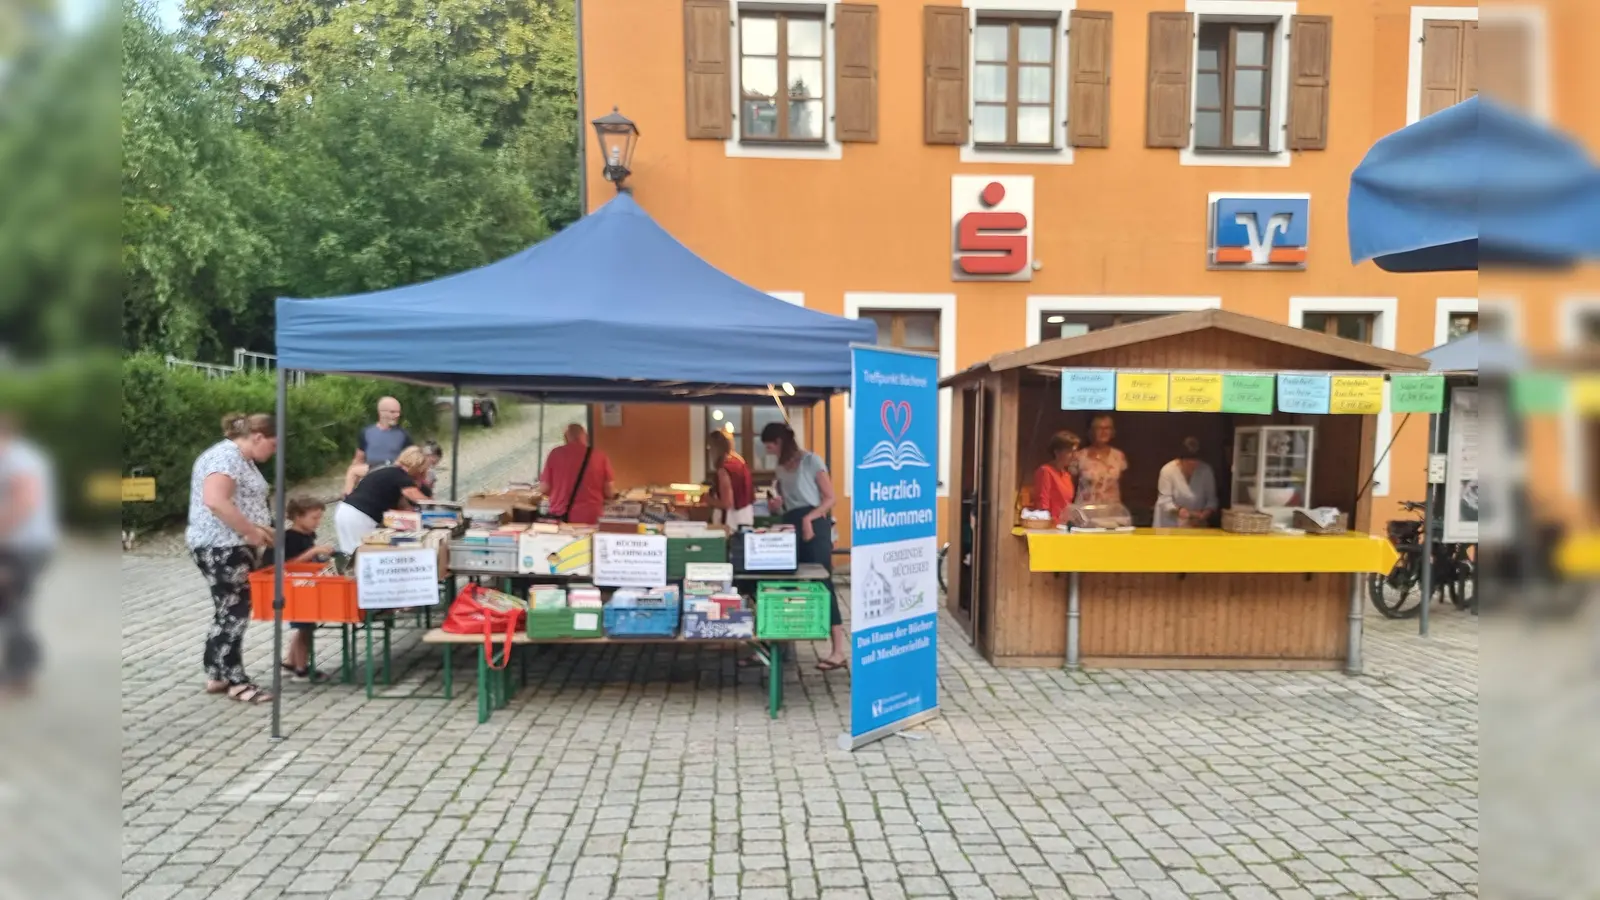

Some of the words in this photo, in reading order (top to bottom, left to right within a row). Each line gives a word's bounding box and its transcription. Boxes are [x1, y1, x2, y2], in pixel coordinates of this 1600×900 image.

[869, 479, 921, 501] Herzlich
[855, 508, 933, 530] Willkommen
[883, 546, 924, 563] GEMEINDE
[892, 561, 930, 578] BÜCHEREI
[857, 636, 871, 649] Das
[872, 631, 894, 644] Haus
[895, 626, 908, 639] der
[908, 620, 934, 635] Bücher
[861, 649, 877, 666] und
[876, 635, 931, 661] Medienvielfalt
